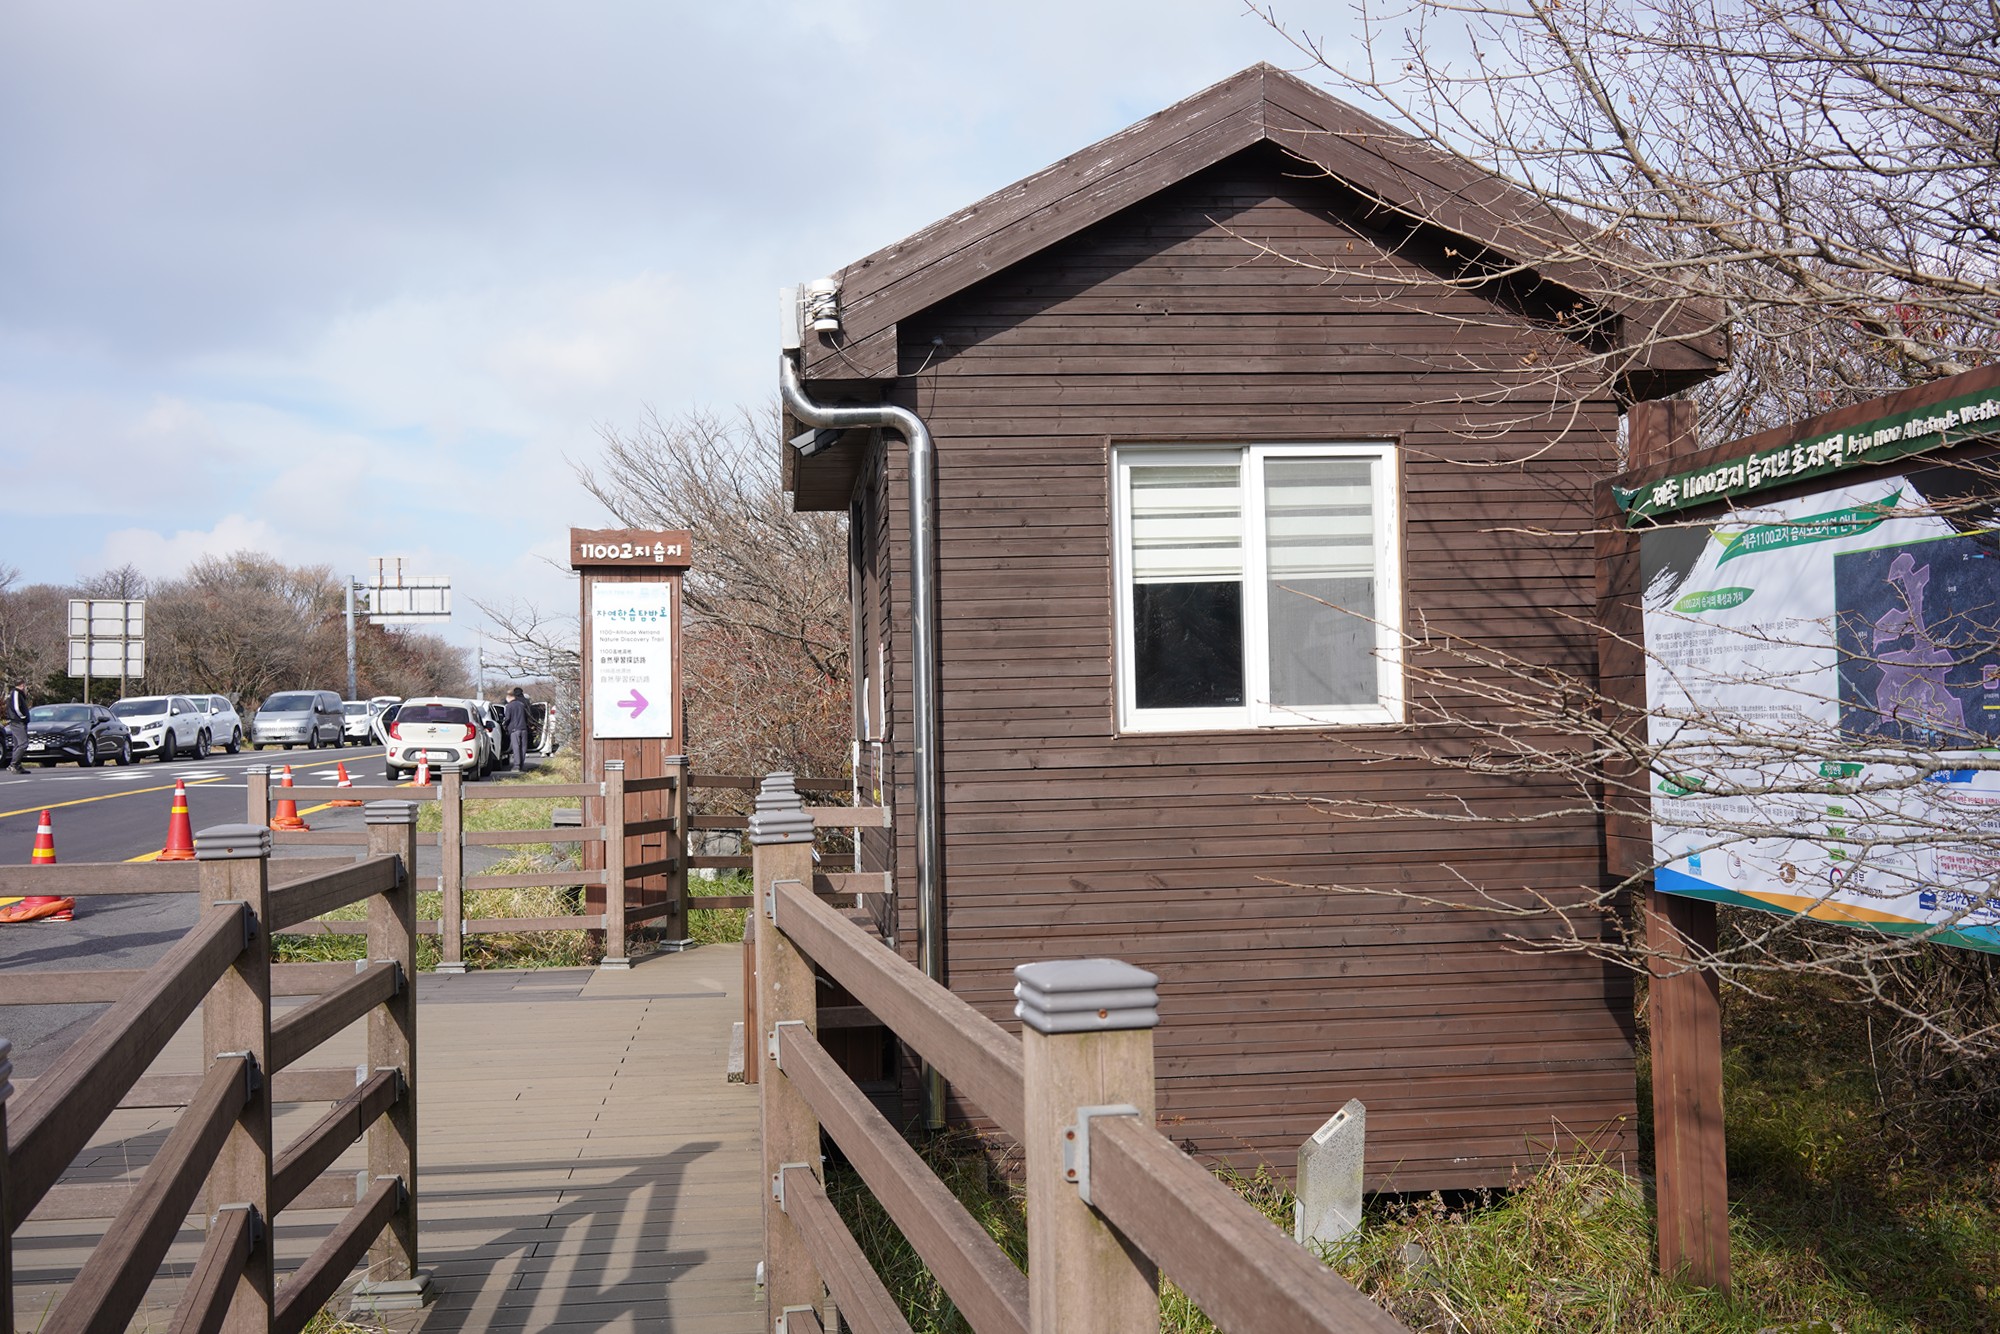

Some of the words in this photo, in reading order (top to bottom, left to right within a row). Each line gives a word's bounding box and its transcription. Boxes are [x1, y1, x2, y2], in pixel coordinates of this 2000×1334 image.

[1846, 433, 1872, 456] Jeju
[1902, 410, 1959, 440] Altitude
[1653, 479, 1680, 507] 제주
[1683, 464, 1744, 499] 1100고지
[1746, 433, 1843, 488] 습지보호지역
[580, 543, 650, 559] 1100고지
[653, 541, 682, 562] 습지
[596, 606, 668, 622] 자연학습탐방로
